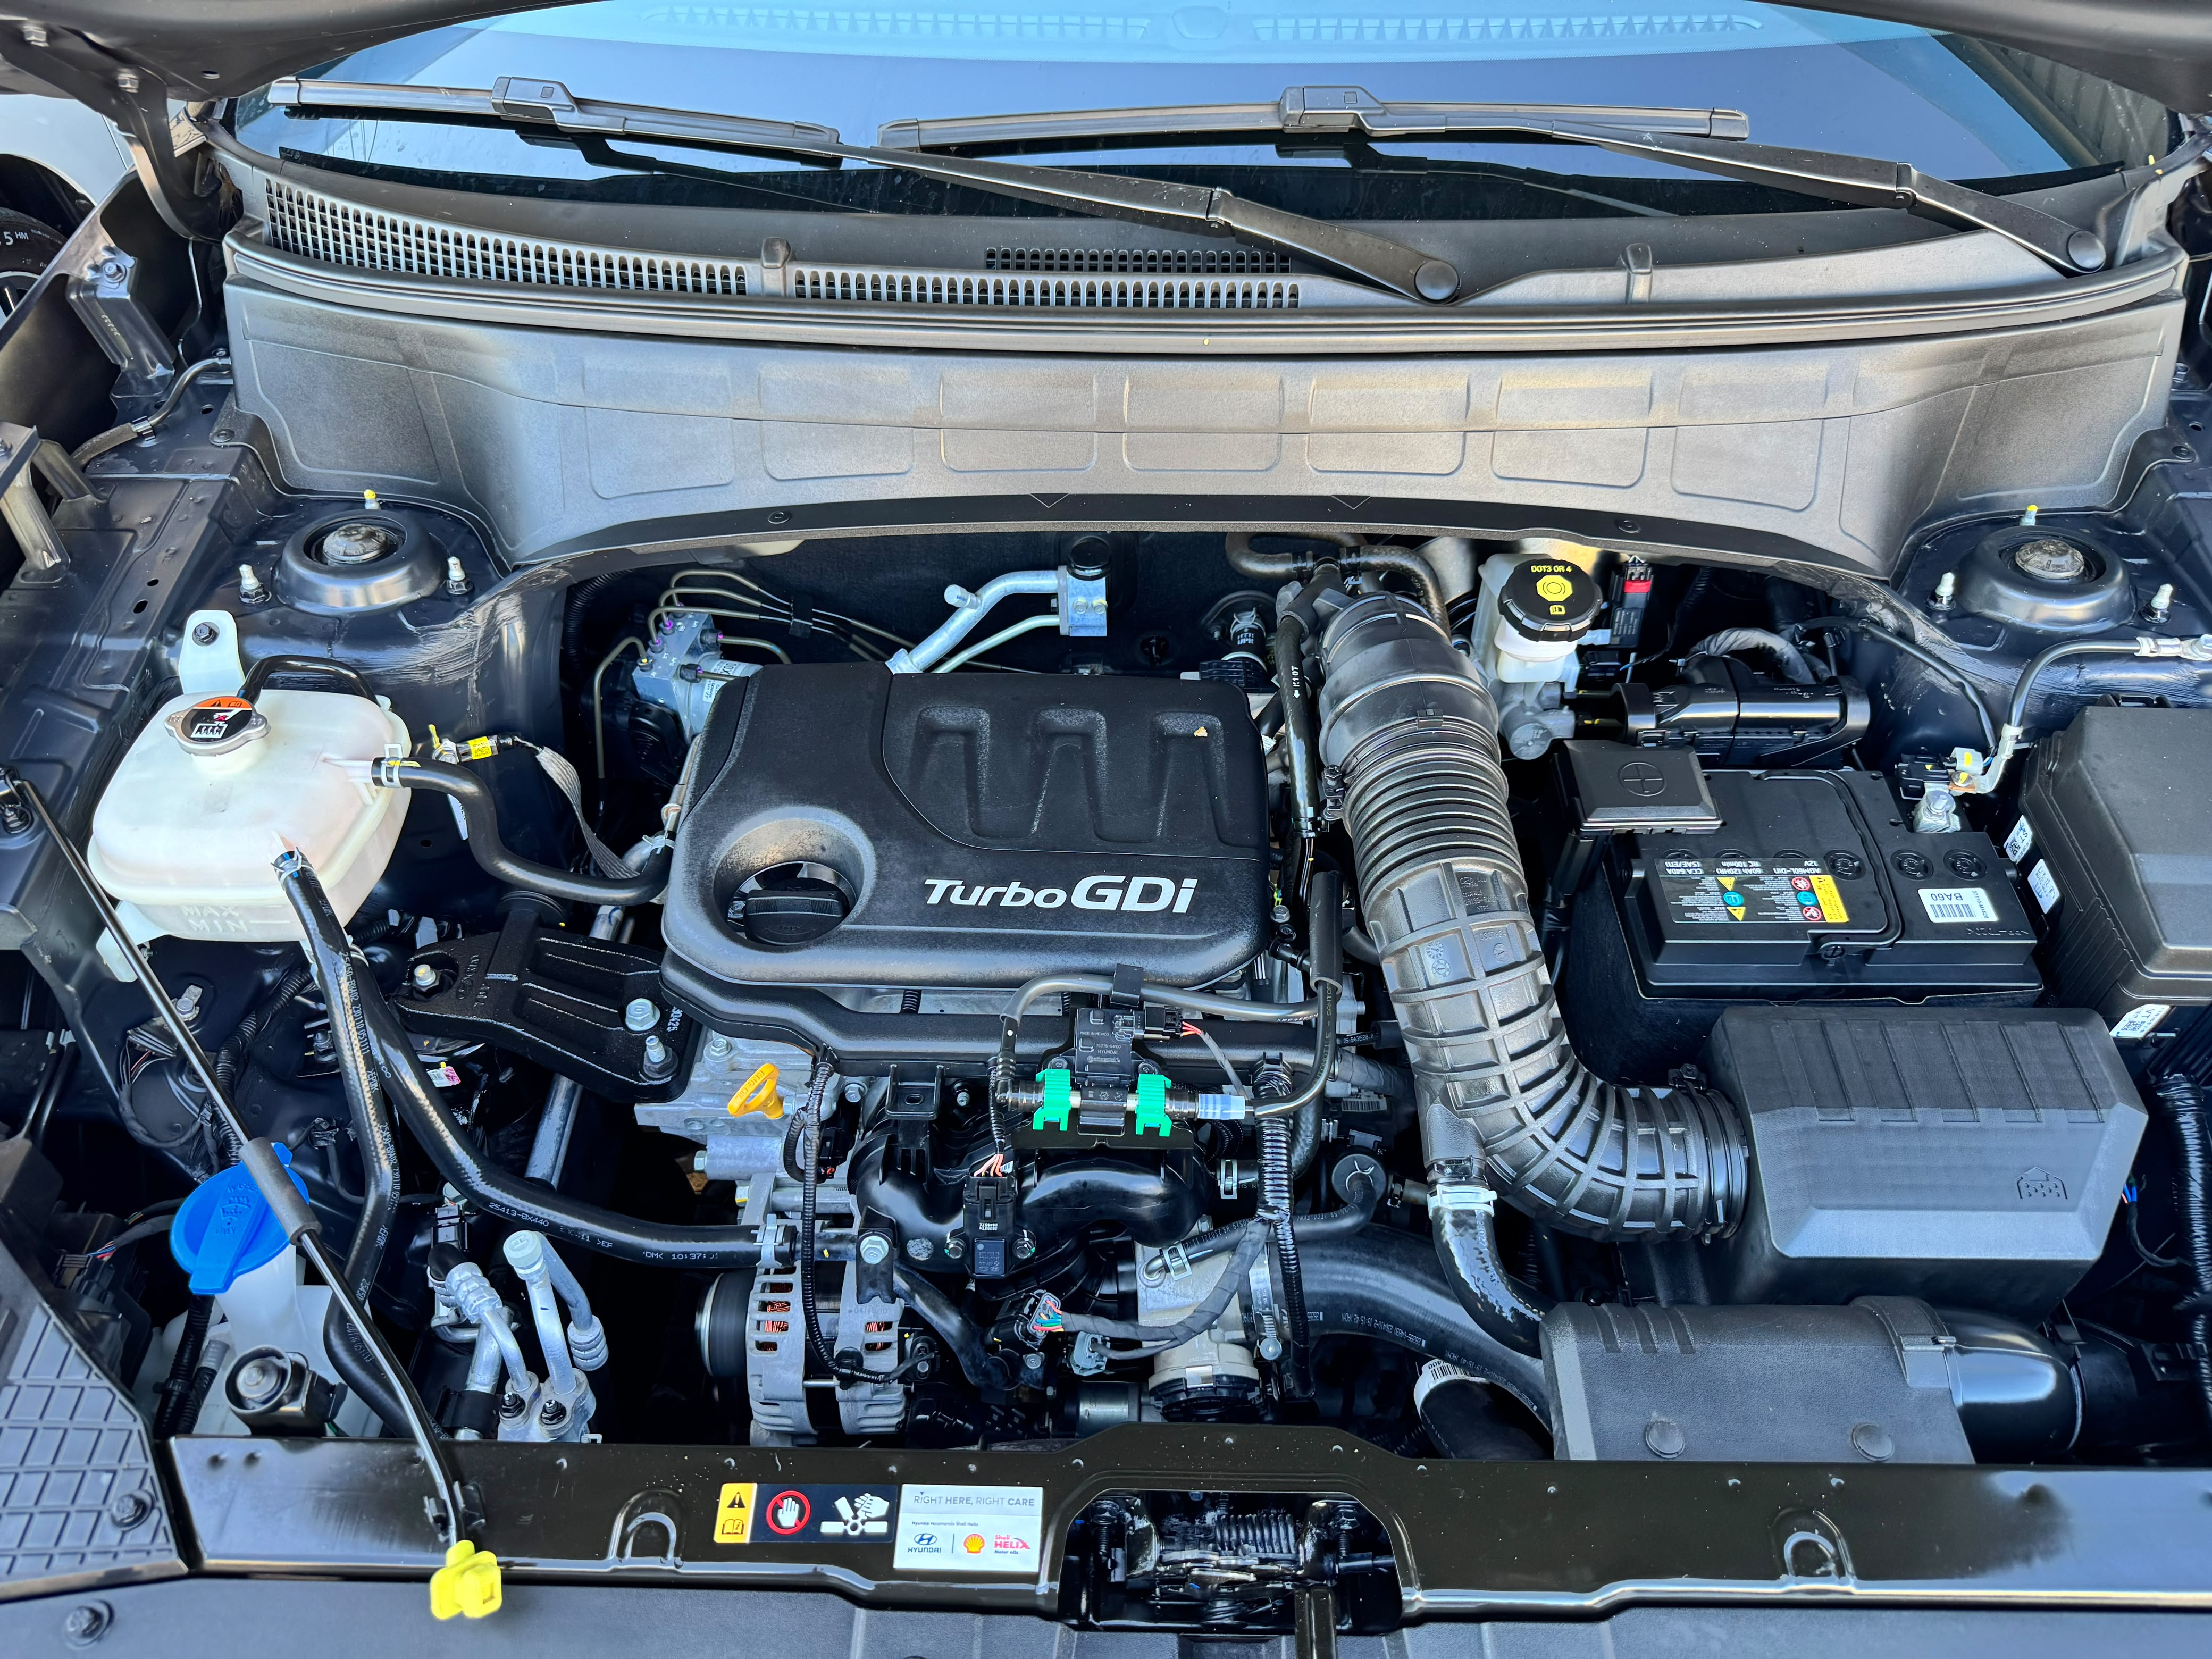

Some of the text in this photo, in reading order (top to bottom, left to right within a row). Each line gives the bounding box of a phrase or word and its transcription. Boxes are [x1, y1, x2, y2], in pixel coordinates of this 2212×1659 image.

[15, 231, 29, 240] HM
[181, 906, 239, 917] MAX
[188, 920, 248, 932] MIN
[748, 1070, 765, 1087] ENG
[488, 1202, 549, 1227] 25413-BX440
[356, 1278, 371, 1301] 25450
[945, 1497, 973, 1505] HERE,
[1008, 1498, 1034, 1506] CARE
[994, 1540, 1030, 1549] HELIX
